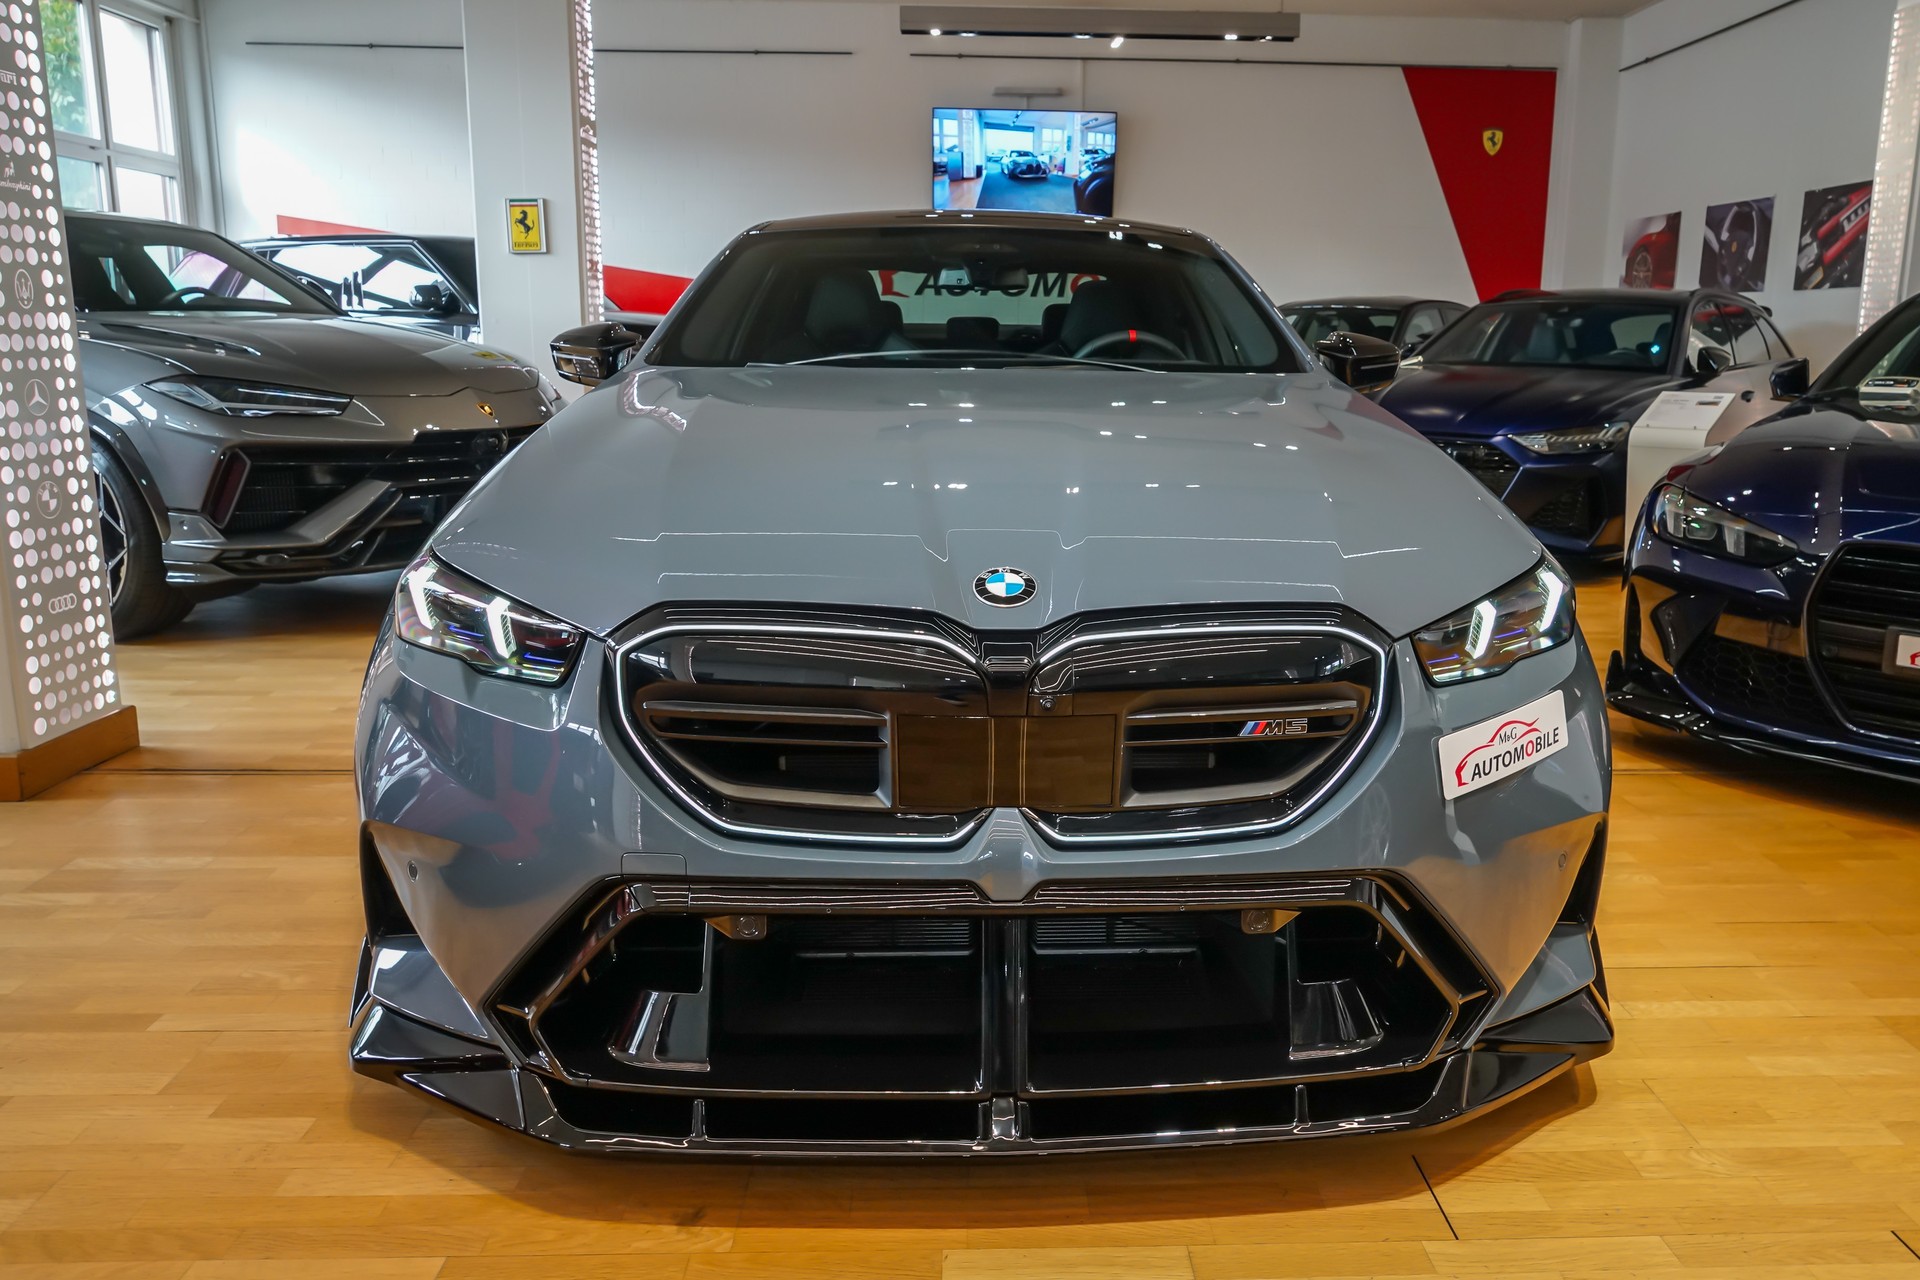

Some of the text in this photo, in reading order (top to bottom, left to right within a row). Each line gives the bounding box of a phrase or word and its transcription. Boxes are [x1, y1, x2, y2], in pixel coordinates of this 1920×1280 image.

[1260, 718, 1308, 735] M5
[1499, 727, 1518, 745] M&G
[1471, 727, 1559, 781] AUTOMOBILE
